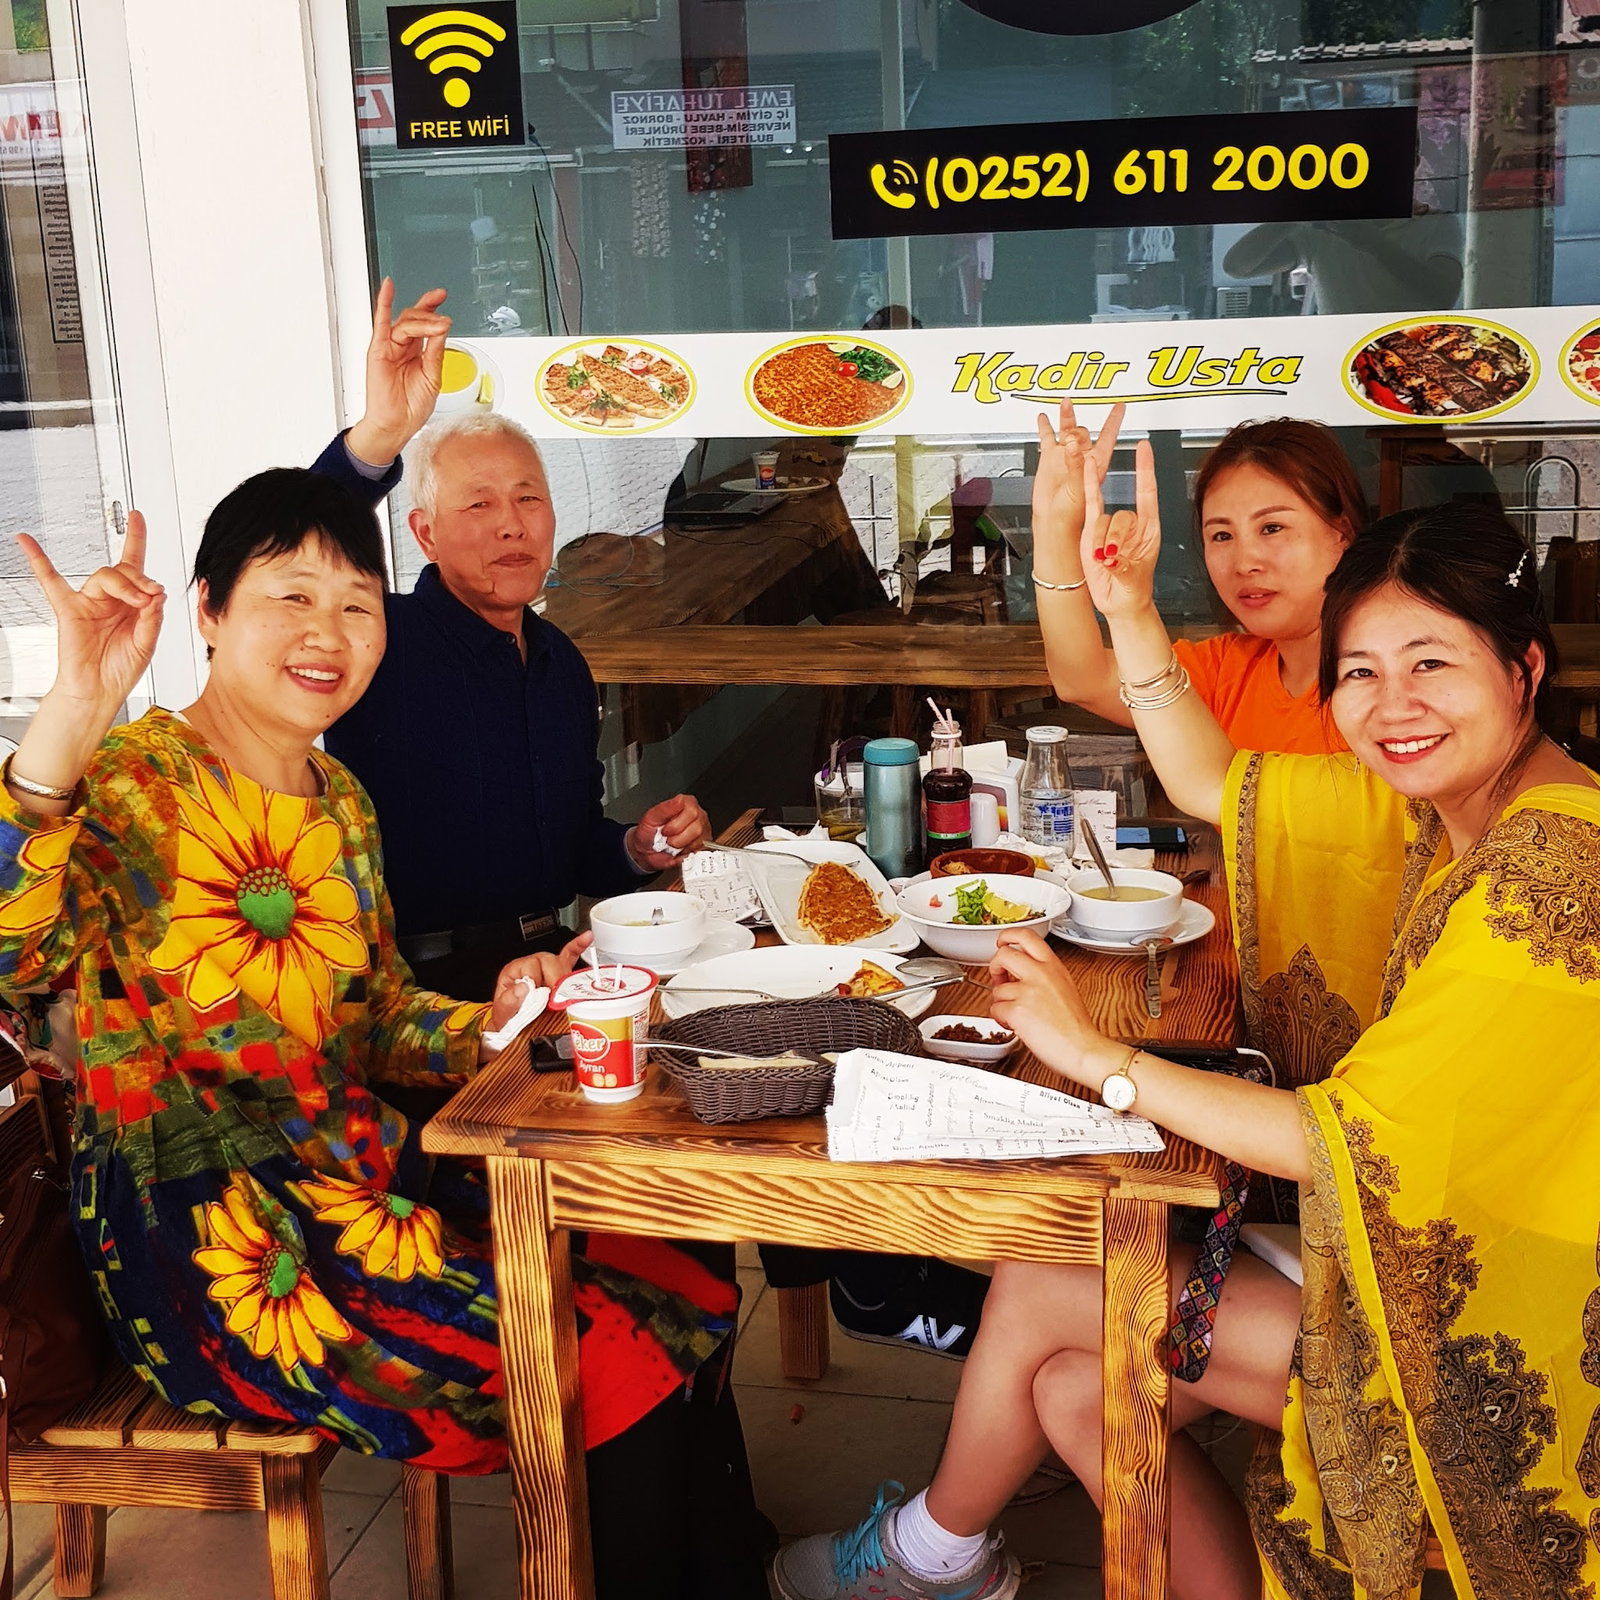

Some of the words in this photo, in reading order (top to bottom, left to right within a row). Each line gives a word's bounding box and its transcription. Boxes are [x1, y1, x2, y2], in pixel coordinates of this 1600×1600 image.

[410, 120, 463, 139] FREE
[925, 149, 1090, 209] (0252)
[1113, 148, 1188, 195] 611
[1211, 142, 1369, 191] 2000
[951, 351, 1130, 404] Kadir
[1147, 345, 1305, 388] Usta
